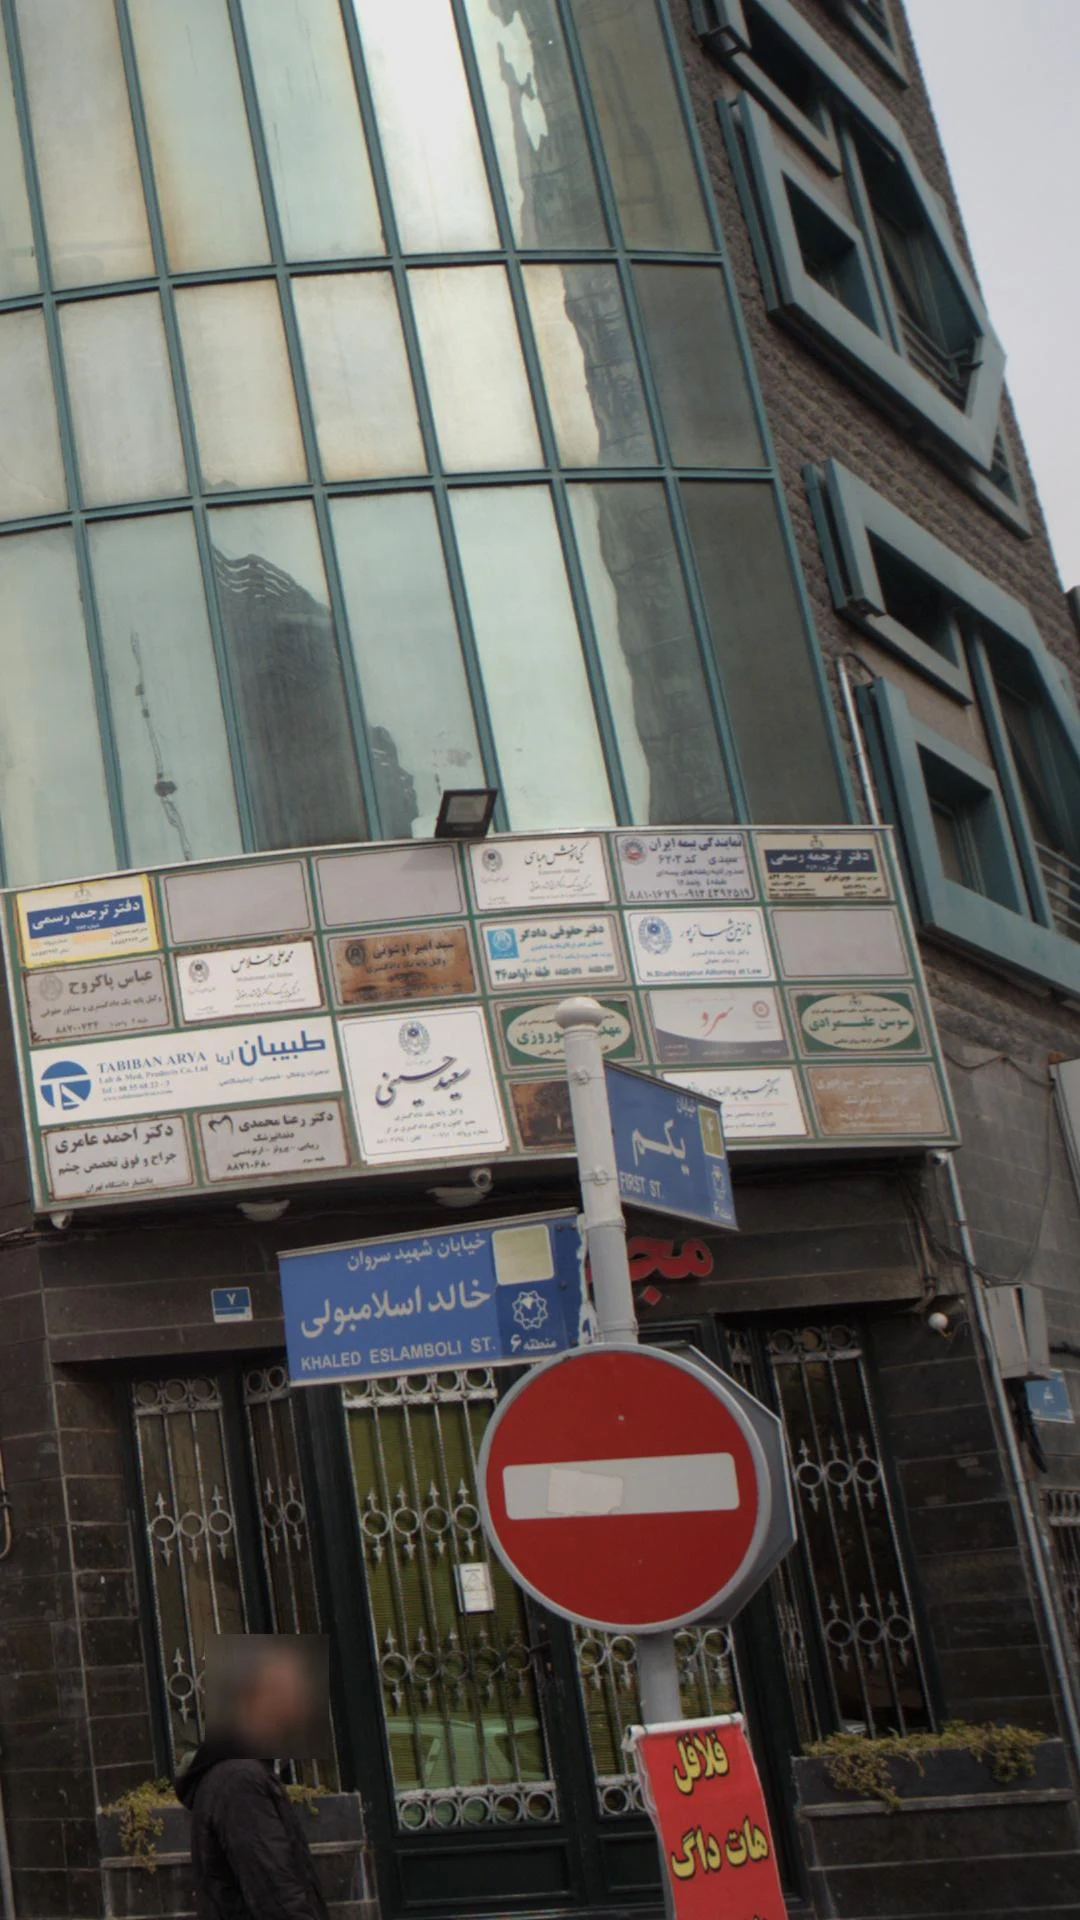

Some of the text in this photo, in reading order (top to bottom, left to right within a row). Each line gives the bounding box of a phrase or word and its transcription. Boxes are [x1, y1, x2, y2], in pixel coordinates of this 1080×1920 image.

[649, 835, 743, 852] نمایندگی بیمه ایران
[769, 850, 870, 866] دفتر ترجمه رسمی
[71, 903, 110, 921] ترجمه
[113, 898, 141, 919] دفتر
[31, 914, 71, 931] رسمی
[550, 925, 584, 940] حقوقی
[584, 923, 605, 938] دفتر
[68, 968, 153, 995] عباس پاکروح
[878, 1019, 910, 1030] سوسن
[238, 1029, 326, 1067] طبیبان
[98, 1051, 207, 1074] TABIBAN ARYA
[99, 1077, 115, 1085] Lab
[375, 1055, 472, 1109] سعید حسینی
[675, 1096, 698, 1118] خیابان
[239, 1111, 334, 1133] دکتر رضا محمدی
[55, 1123, 174, 1154] دکتر احمد عامری
[631, 1119, 690, 1177] یکم
[58, 1151, 177, 1176] جراح و فوق تخصص چشم
[619, 1171, 646, 1194] FIRST
[347, 1232, 487, 1272] خیابان شهید سروان
[226, 1291, 237, 1305] ۷
[300, 1278, 492, 1340] خالد اسلامبولی
[509, 1334, 558, 1352] منطقه ۶
[300, 1338, 497, 1371] KHALED ESLAMBOLI ST.
[673, 1729, 730, 1795] فلافل
[671, 1813, 769, 1880] هات داگ
